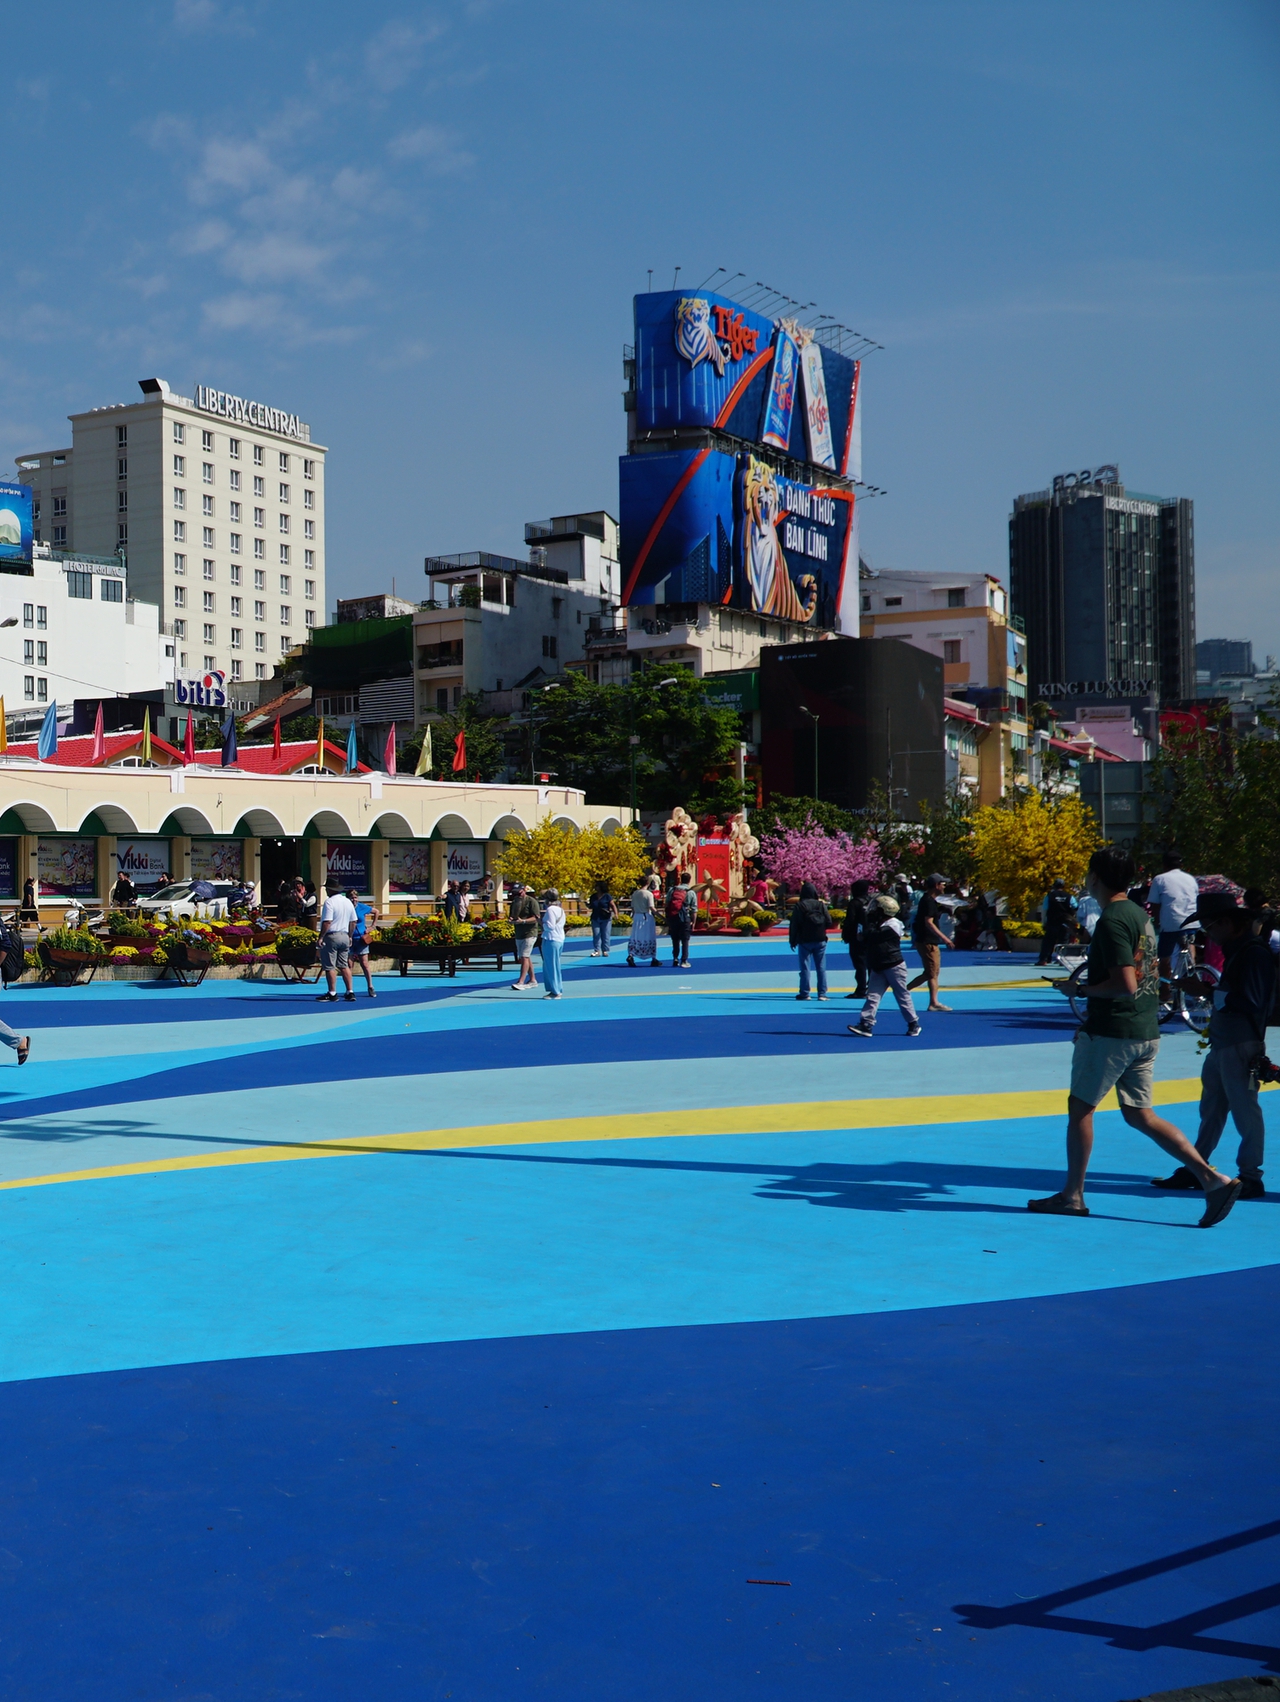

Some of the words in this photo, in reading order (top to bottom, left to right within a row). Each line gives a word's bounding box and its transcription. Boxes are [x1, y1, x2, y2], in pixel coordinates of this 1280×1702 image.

[714, 305, 759, 360] Tiger
[786, 481, 811, 518] ĐÁNH
[813, 492, 835, 527] THỨC
[786, 516, 804, 553] BẢN
[807, 526, 827, 562] LĨNH
[1038, 683, 1079, 696] KING
[1084, 680, 1151, 694] LUXURY
[117, 844, 149, 870] Vikki
[150, 862, 165, 870] Bank
[327, 847, 352, 870] Vikki
